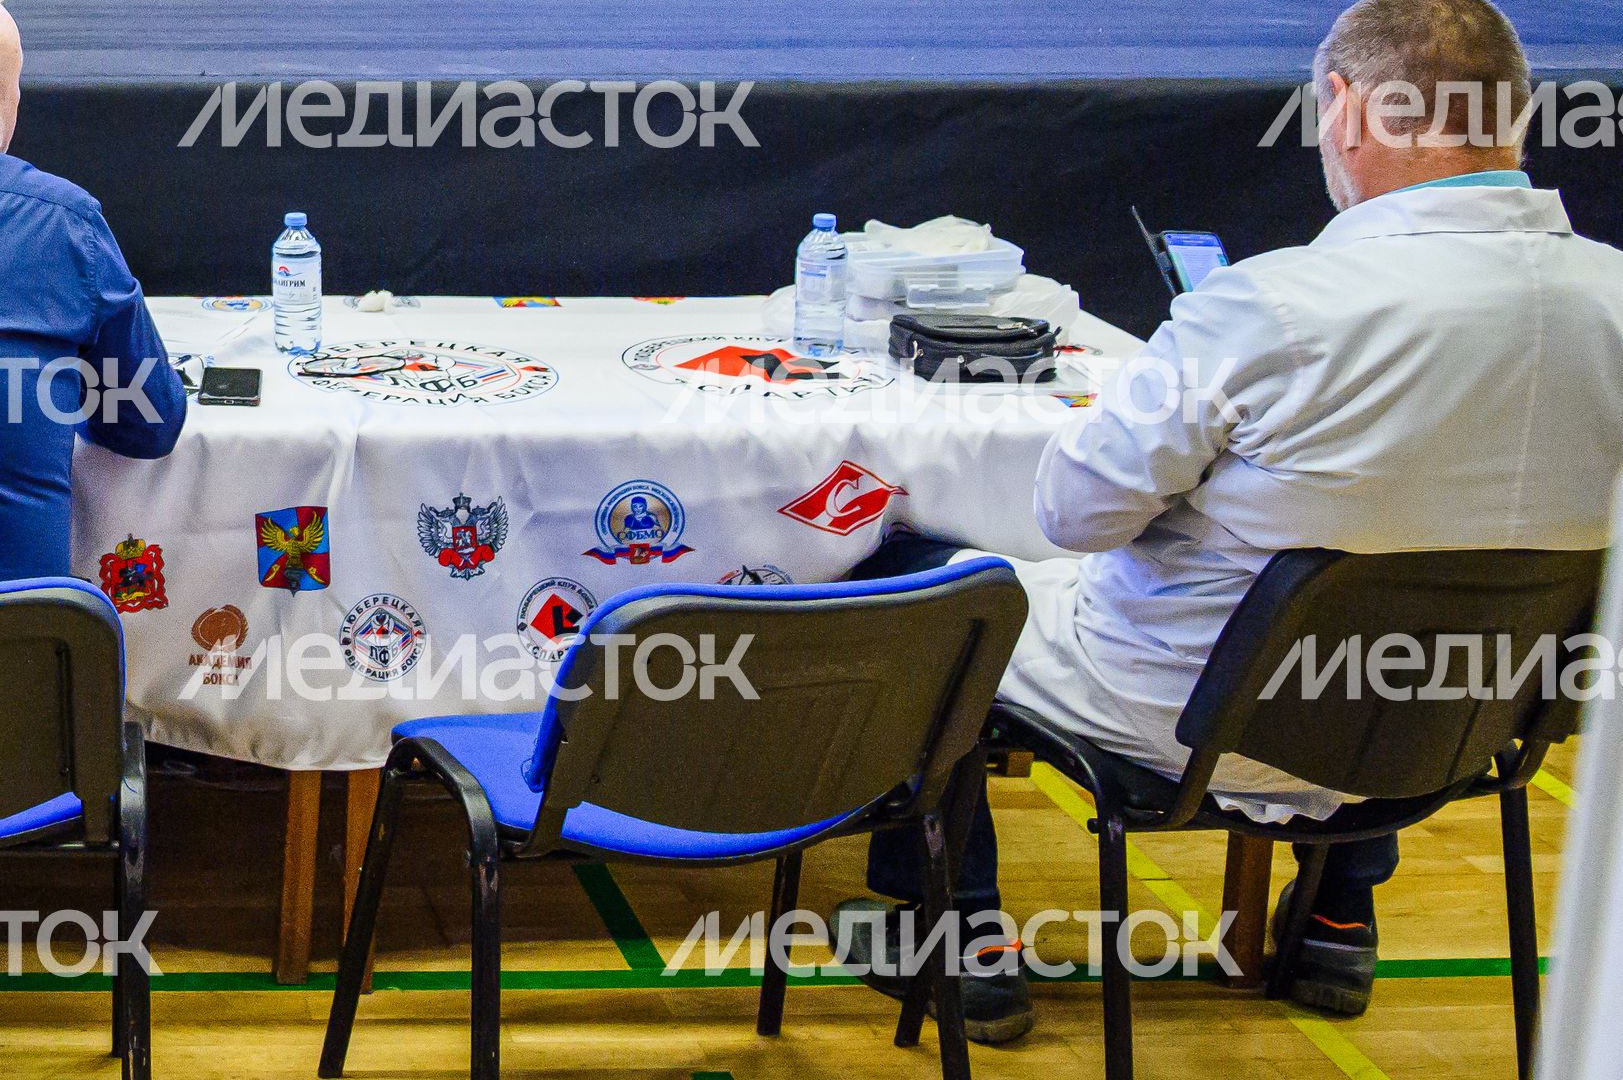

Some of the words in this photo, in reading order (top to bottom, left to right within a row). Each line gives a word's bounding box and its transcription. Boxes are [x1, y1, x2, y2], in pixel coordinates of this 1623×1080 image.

[617, 530, 664, 541] СФБМО
[342, 596, 422, 633] ЛЮБЕРЕЦКАЯ
[188, 652, 253, 670] АКАДЕМИЯ
[345, 648, 399, 680] ФЕДЕРАЦИЯ
[401, 642, 424, 672] БОКСА
[202, 672, 240, 687] БОКСА
